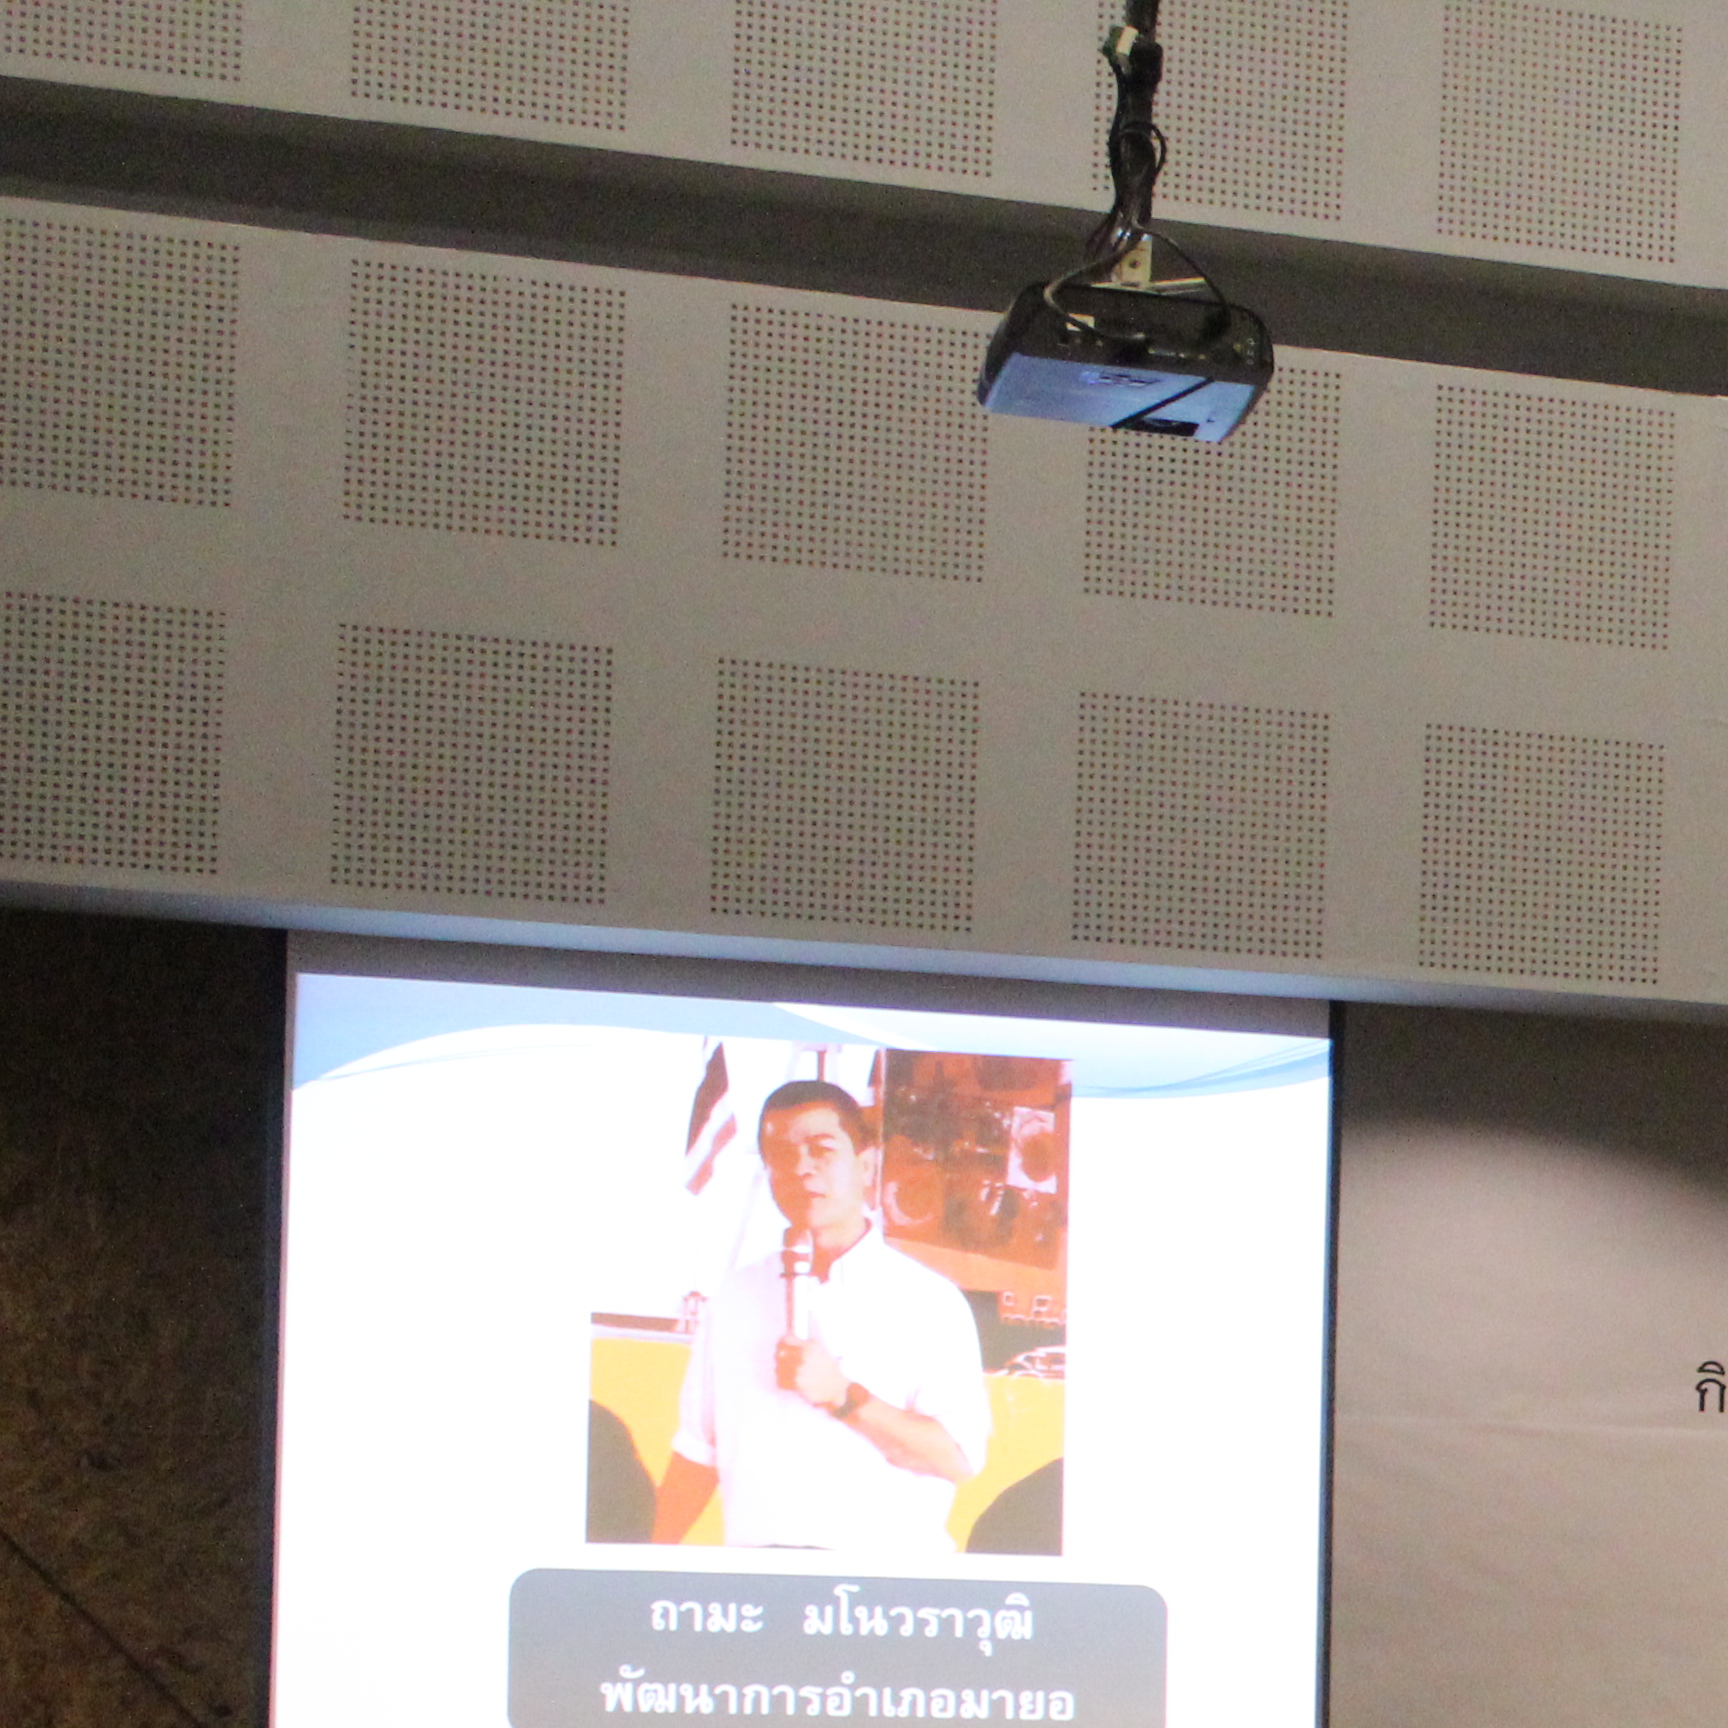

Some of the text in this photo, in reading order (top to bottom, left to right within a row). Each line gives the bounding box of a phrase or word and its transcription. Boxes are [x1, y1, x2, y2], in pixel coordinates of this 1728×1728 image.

[651, 1584, 1032, 1656] ถามะ มโนวราวุฒิ
[600, 1665, 1074, 1721] พัฒนาการอำเภอมายอ
